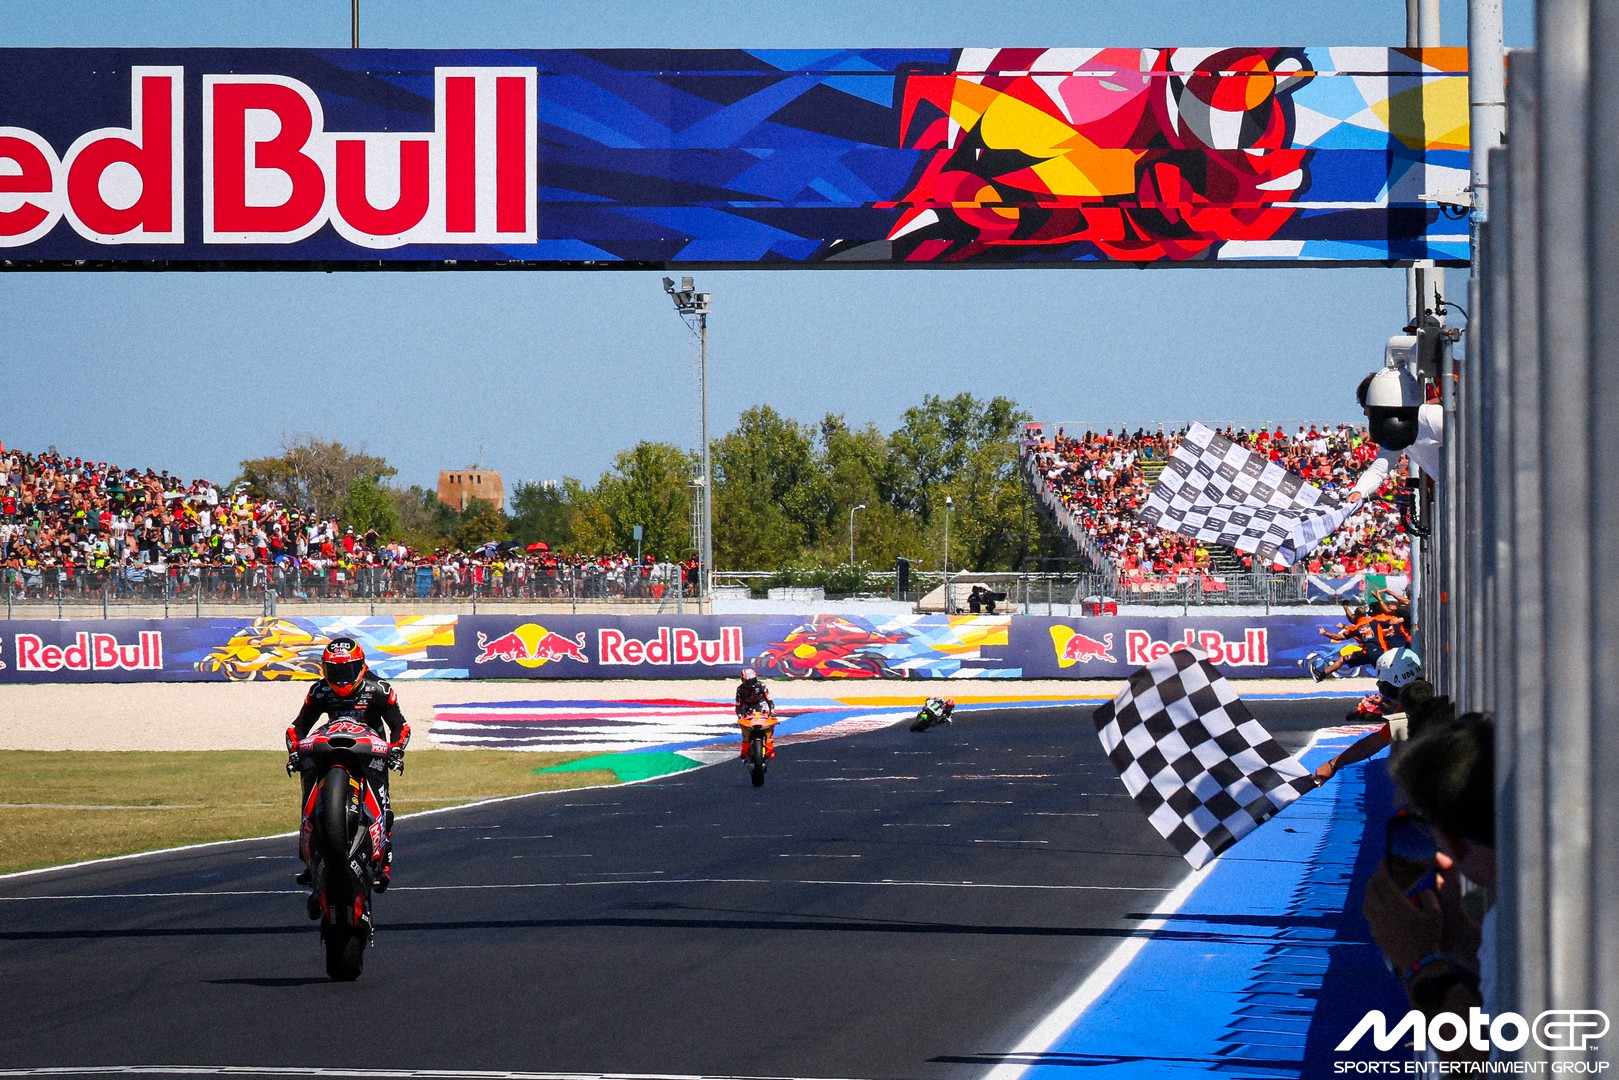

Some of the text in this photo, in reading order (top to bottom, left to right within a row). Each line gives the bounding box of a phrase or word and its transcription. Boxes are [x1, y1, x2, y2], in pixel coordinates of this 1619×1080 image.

[0, 65, 538, 249] ed Bull
[15, 630, 163, 672] Red Bull
[598, 626, 743, 666] Red Bull
[1198, 628, 1269, 666] Bull
